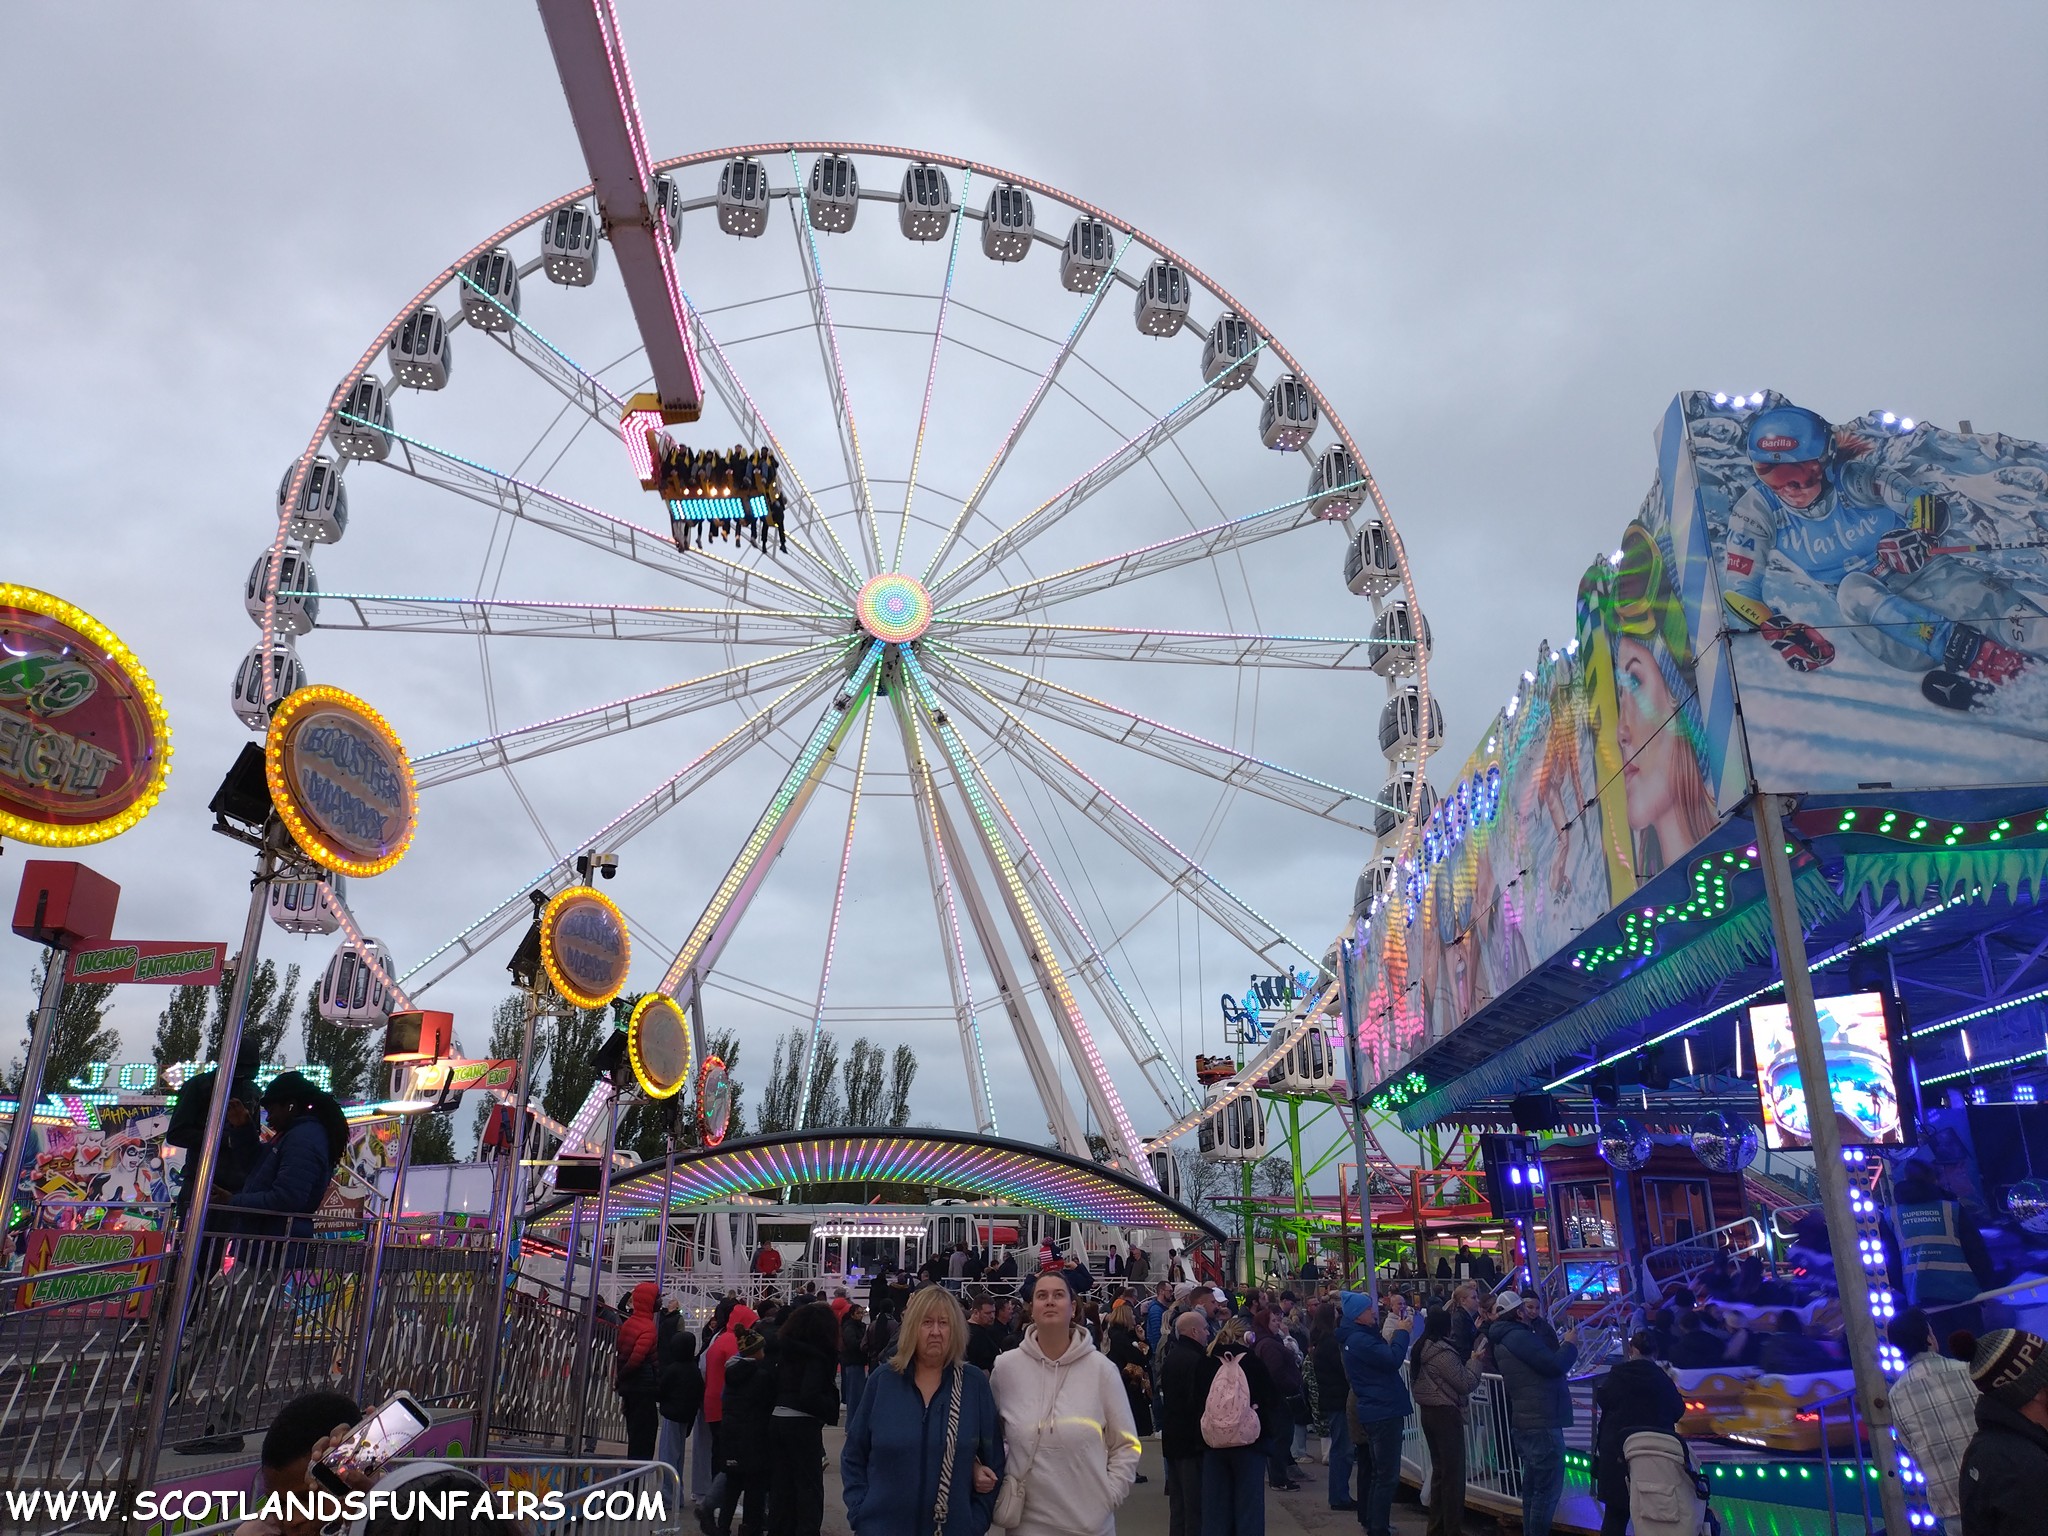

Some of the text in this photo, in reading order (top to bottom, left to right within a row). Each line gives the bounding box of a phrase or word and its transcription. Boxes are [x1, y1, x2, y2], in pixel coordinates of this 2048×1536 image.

[1761, 439, 1792, 448] Barilla
[1782, 513, 1879, 565] Marlene
[1740, 604, 1760, 621] LEKI
[74, 946, 216, 981] INGANG ENTRANCE
[487, 1067, 511, 1086] EXIT
[315, 1208, 356, 1219] AUTION
[1903, 1217, 1941, 1225] ATTENDANT
[51, 1233, 135, 1266] INGANG
[32, 1270, 140, 1303] ENTRANCE
